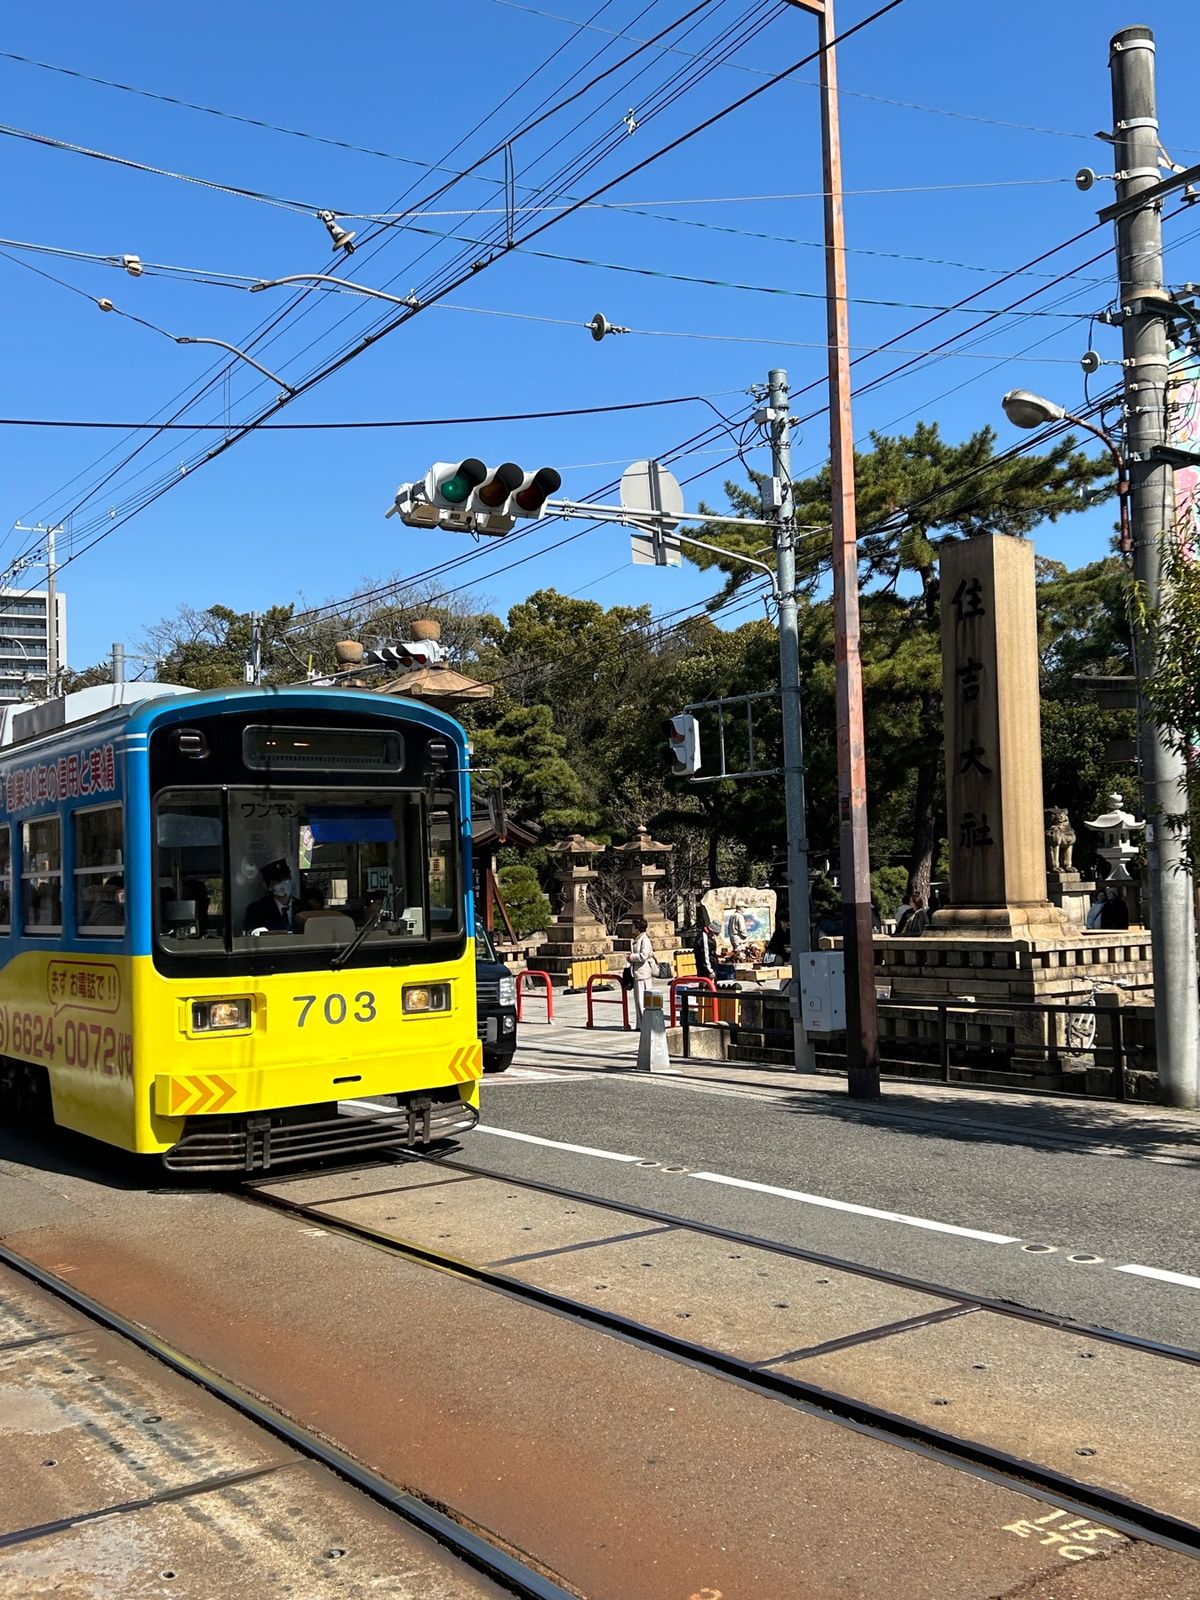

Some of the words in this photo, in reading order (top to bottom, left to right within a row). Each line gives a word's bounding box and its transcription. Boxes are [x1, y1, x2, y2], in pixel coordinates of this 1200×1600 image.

[950, 577, 994, 848] 住吉大社
[293, 990, 377, 1028] 703
